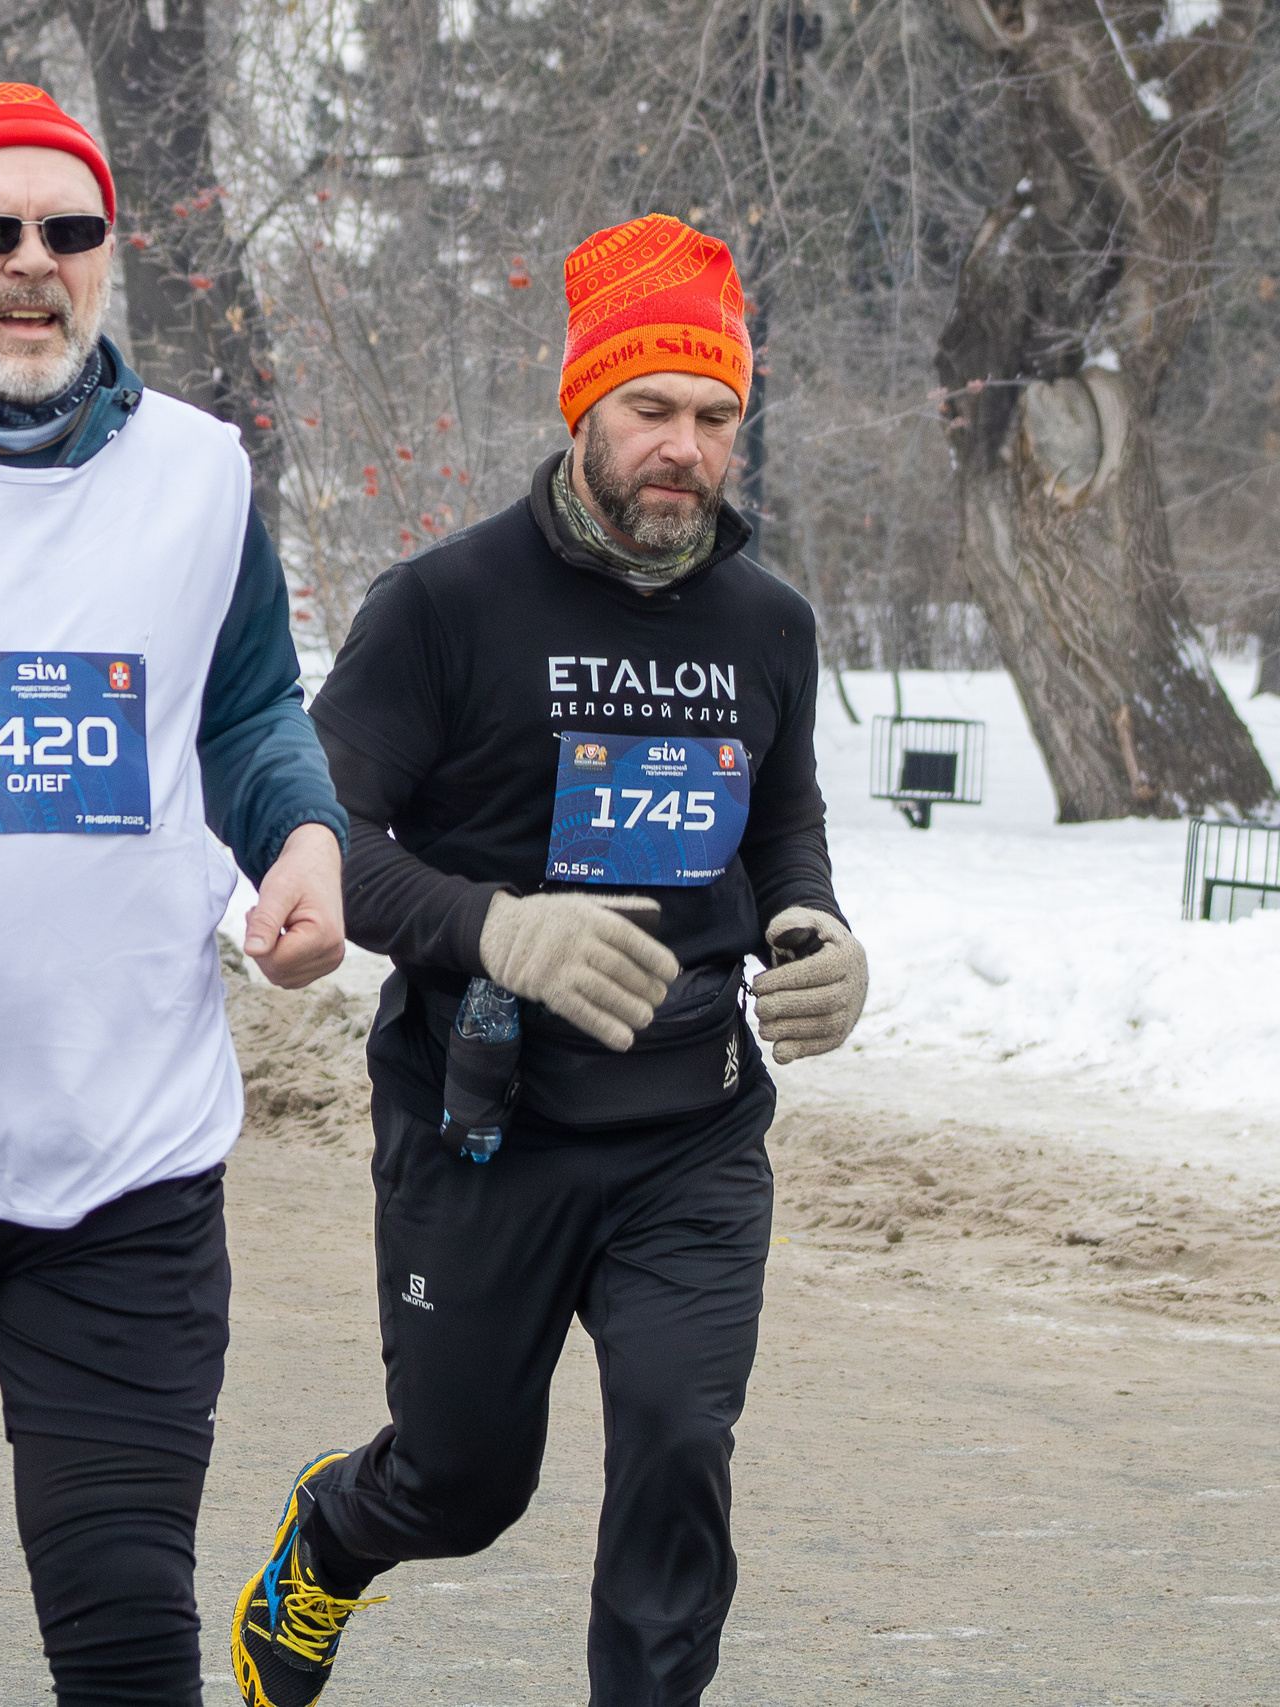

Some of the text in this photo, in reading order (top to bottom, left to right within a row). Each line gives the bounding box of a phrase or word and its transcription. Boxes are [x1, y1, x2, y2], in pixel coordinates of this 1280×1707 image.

[548, 656, 736, 701] ETALON
[550, 702, 738, 723] ДЕЛОВОЙ КЛУБ
[7, 774, 71, 792] ОЛЕГ
[591, 787, 716, 831] 1745
[75, 815, 83, 824] 7
[122, 816, 145, 825] 2025
[553, 862, 589, 876] 10,55
[675, 869, 681, 878] 7
